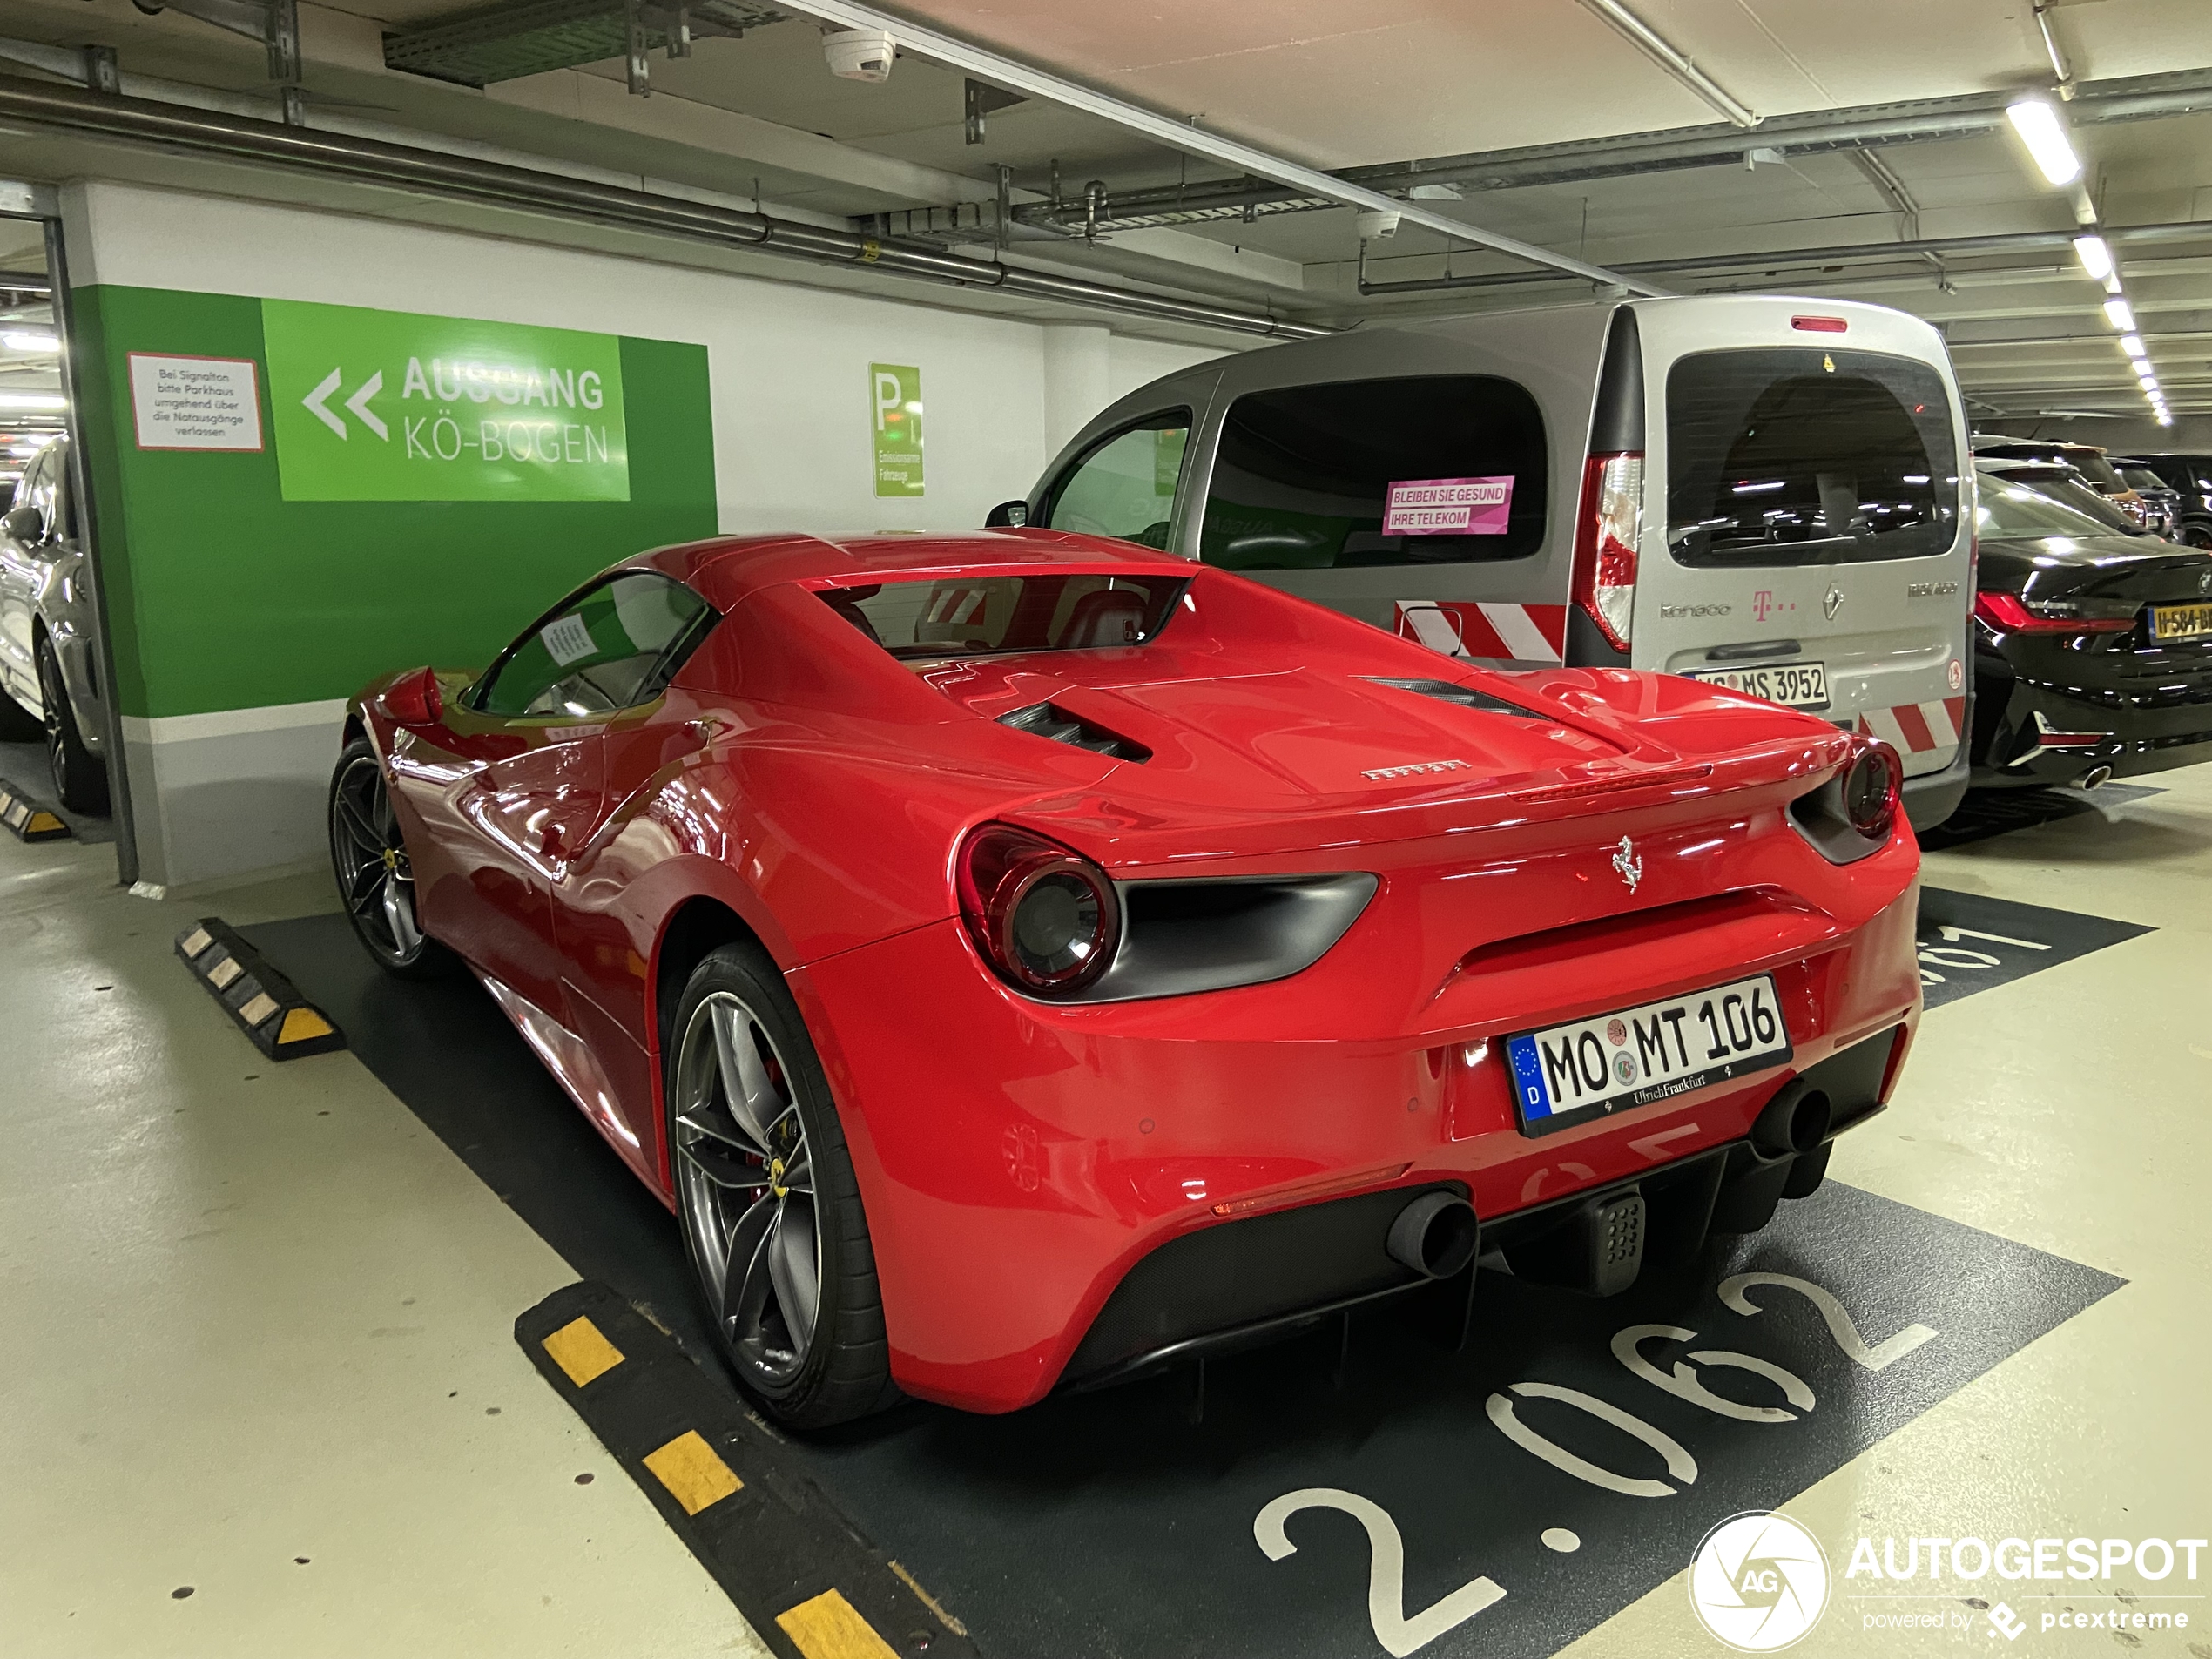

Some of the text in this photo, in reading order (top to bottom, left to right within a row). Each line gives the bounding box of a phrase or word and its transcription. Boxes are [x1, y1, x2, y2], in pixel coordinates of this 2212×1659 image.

[158, 368, 230, 382] Bei Signalton
[402, 356, 604, 410] AUSGANG
[157, 383, 234, 396] bitte Parkhaus
[154, 399, 239, 410] umgehend über
[875, 373, 901, 430] P
[153, 411, 244, 426] die Notausgänge
[174, 426, 226, 436] verlassen
[404, 409, 608, 463] KÖ-BOGEN
[1393, 487, 1504, 503] BLEIBEN SIE GESUND
[1391, 512, 1467, 526] IHRE TELEKOM
[1773, 669, 1824, 700] 3952
[1541, 1030, 1609, 1103] MO
[1631, 1006, 1689, 1078] MT
[1698, 987, 1777, 1060] 106
[1527, 1086, 1540, 1105] D
[1253, 1271, 1940, 1658] 2.062
